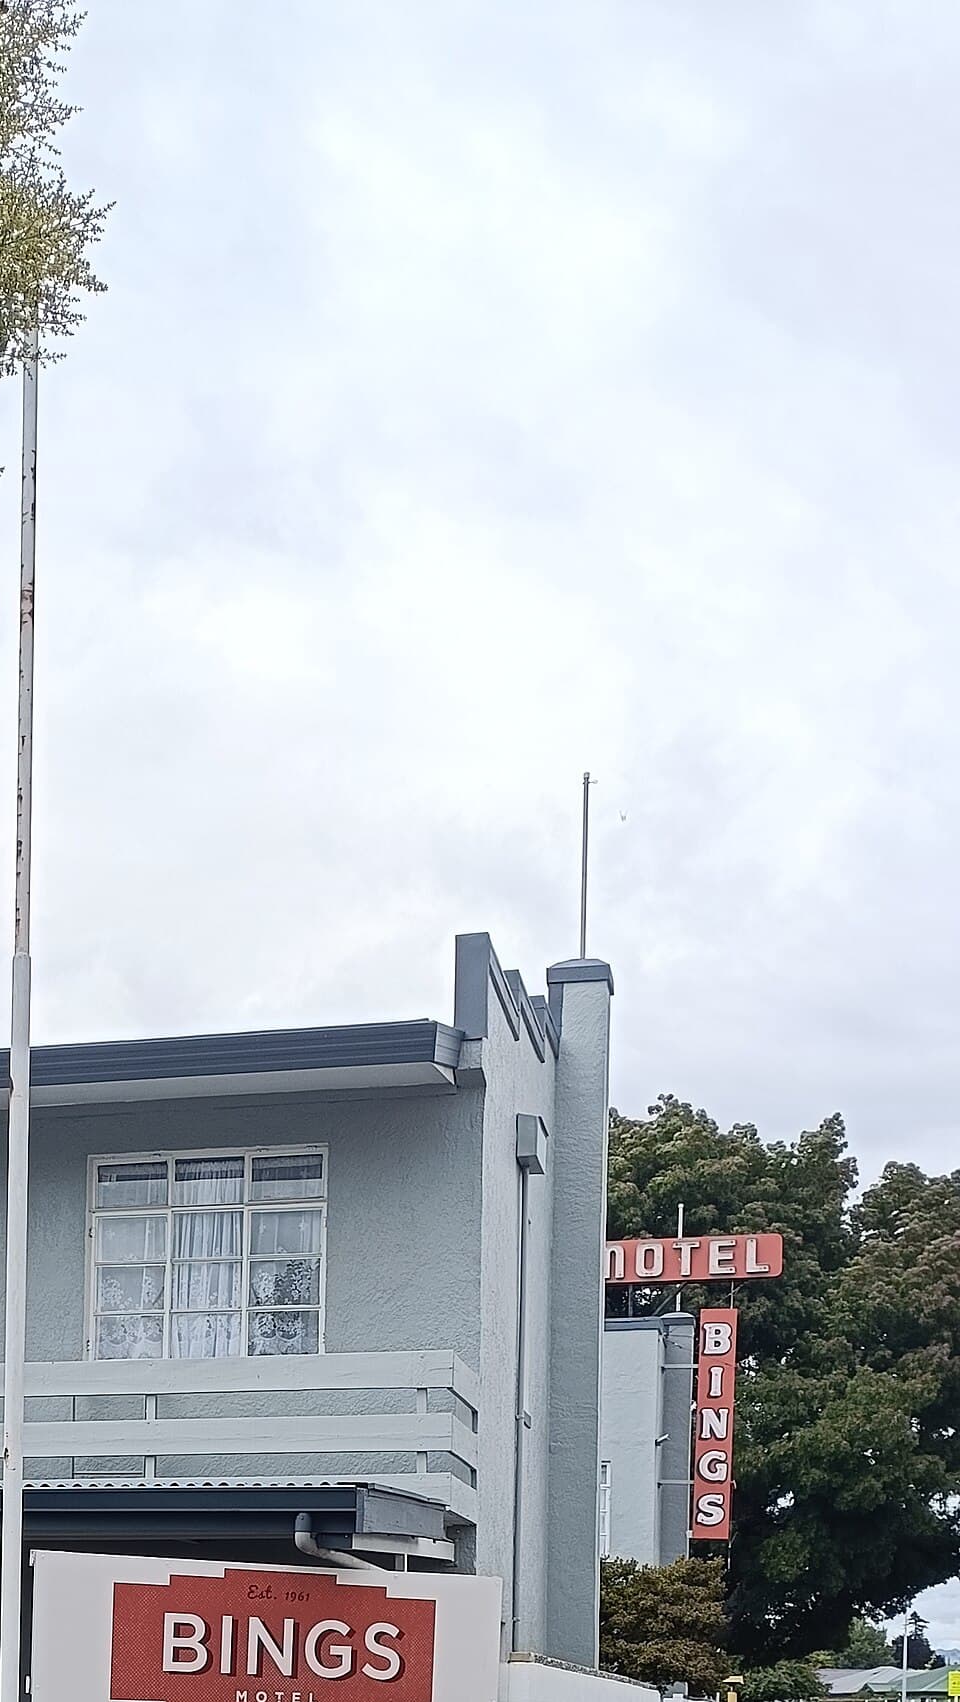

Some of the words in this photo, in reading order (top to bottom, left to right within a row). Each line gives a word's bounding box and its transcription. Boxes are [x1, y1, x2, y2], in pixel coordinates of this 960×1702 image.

[696, 1322, 732, 1526] BINGS
[246, 1584, 278, 1600] Est.
[285, 1591, 311, 1602] 1961
[162, 1612, 404, 1682] BINGS
